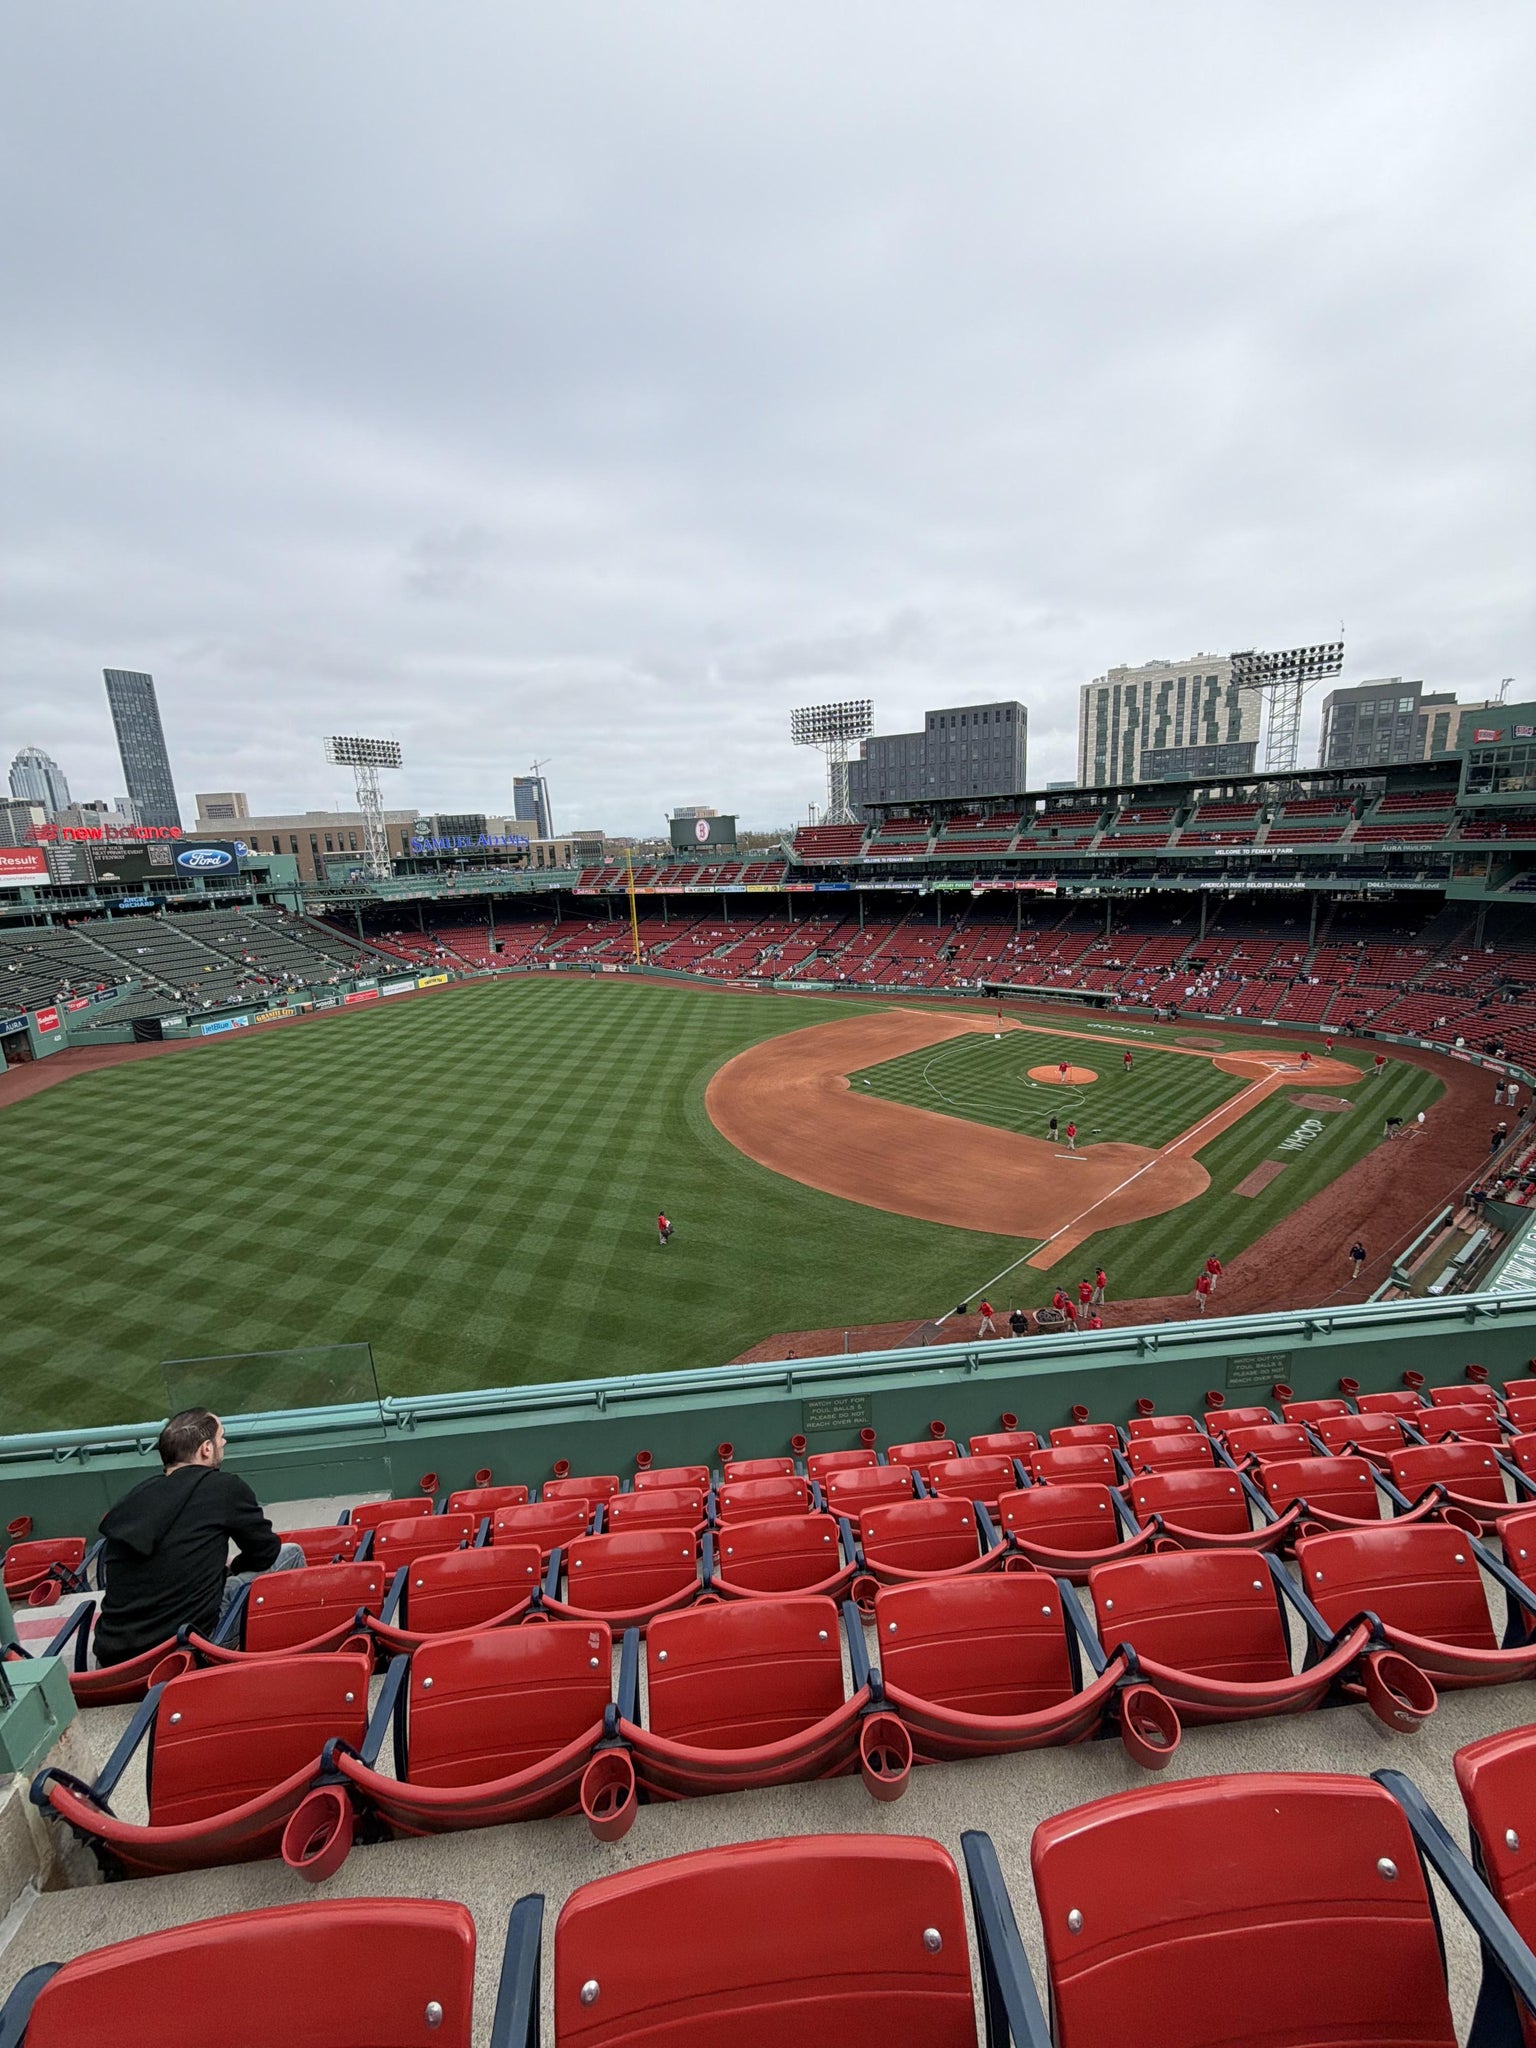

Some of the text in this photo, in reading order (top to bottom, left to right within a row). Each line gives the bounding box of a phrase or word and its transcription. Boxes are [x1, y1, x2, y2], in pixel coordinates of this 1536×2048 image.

[62, 823, 182, 841] new balance
[411, 832, 529, 853] SAMUEL ADAMS
[0, 856, 38, 866] Result
[189, 852, 221, 866] Ford
[255, 1010, 281, 1022] GRANITE
[205, 1021, 229, 1034] jetBlue
[1278, 1119, 1326, 1152] WHOOP
